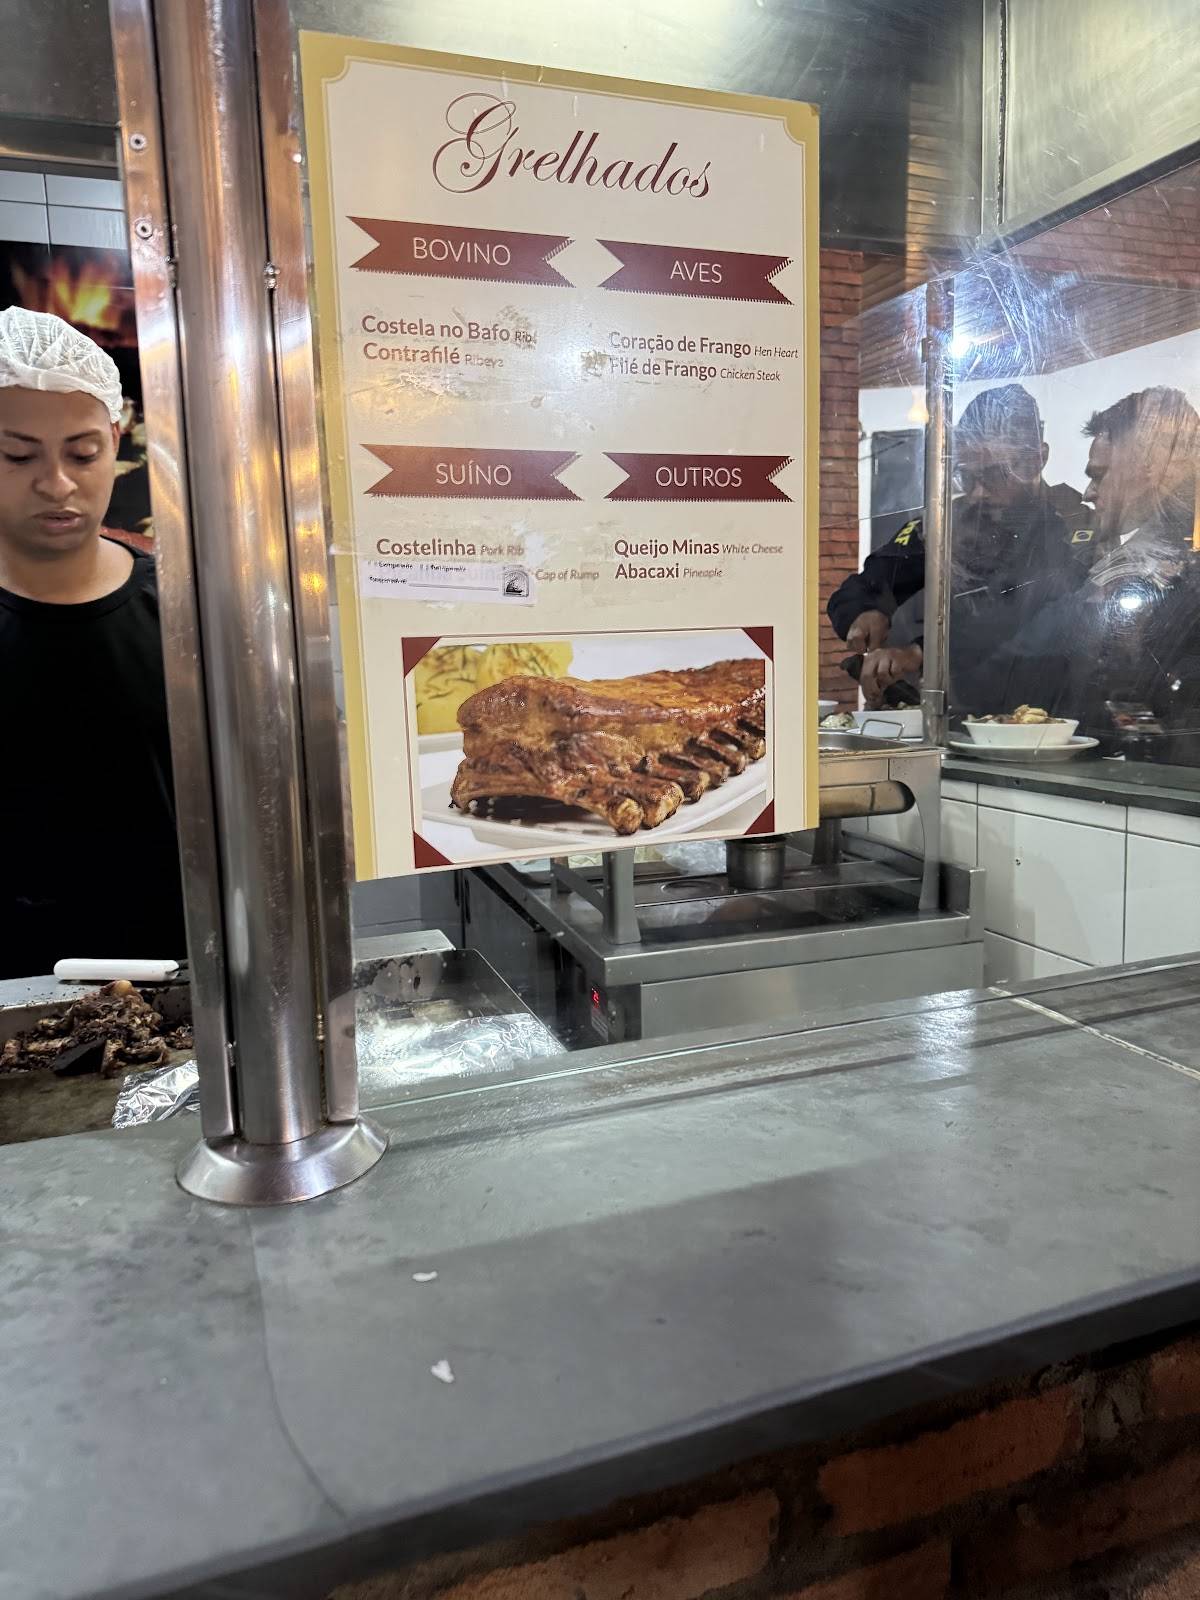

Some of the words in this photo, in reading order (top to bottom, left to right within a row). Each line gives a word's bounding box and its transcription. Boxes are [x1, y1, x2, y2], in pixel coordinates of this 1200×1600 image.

[433, 92, 711, 198] Grelhados
[412, 237, 511, 266] BOVINO
[669, 260, 723, 284] AVES
[362, 315, 435, 337] Costela
[440, 324, 463, 338] no
[468, 322, 510, 342] Bafo
[363, 342, 460, 365] Contrafilé
[609, 331, 674, 354] Coração
[677, 336, 696, 353] de
[700, 337, 751, 358] Frango
[754, 346, 772, 358] Hen
[774, 347, 799, 359] Heart
[642, 358, 661, 375] de
[665, 360, 717, 382] Frango
[720, 368, 755, 381] Chicken
[757, 370, 781, 381] Steak
[435, 460, 512, 487] SUÍNO
[655, 466, 743, 488] OUTROS
[376, 538, 477, 556] Costelinha
[481, 544, 503, 556] Pork
[614, 539, 669, 558] Queijo
[672, 539, 720, 555] Minas
[722, 543, 750, 554] White
[751, 543, 783, 554] Cheese
[535, 568, 556, 581] Cap
[557, 569, 568, 580] of
[569, 569, 600, 581] Rump
[614, 563, 680, 579] Abacaxi
